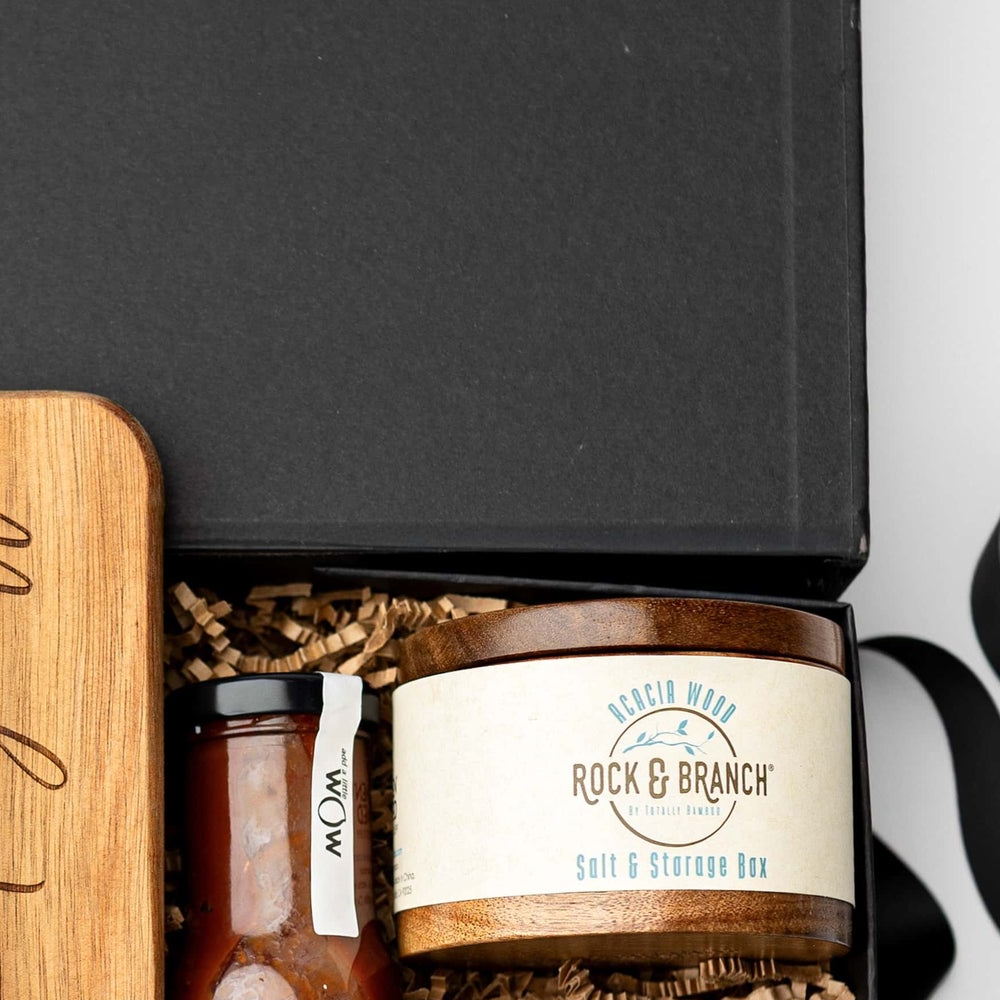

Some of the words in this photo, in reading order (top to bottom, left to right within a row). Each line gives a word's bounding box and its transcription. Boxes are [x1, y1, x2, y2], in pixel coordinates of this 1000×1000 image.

[608, 680, 674, 724] ACACIA
[687, 681, 736, 723] WOOD
[573, 761, 640, 805] ROCK
[649, 757, 669, 799] &
[318, 769, 346, 857] WOW
[577, 853, 617, 880] Salt
[629, 852, 638, 879] &
[650, 852, 727, 879] Storage
[738, 852, 767, 879] Box
